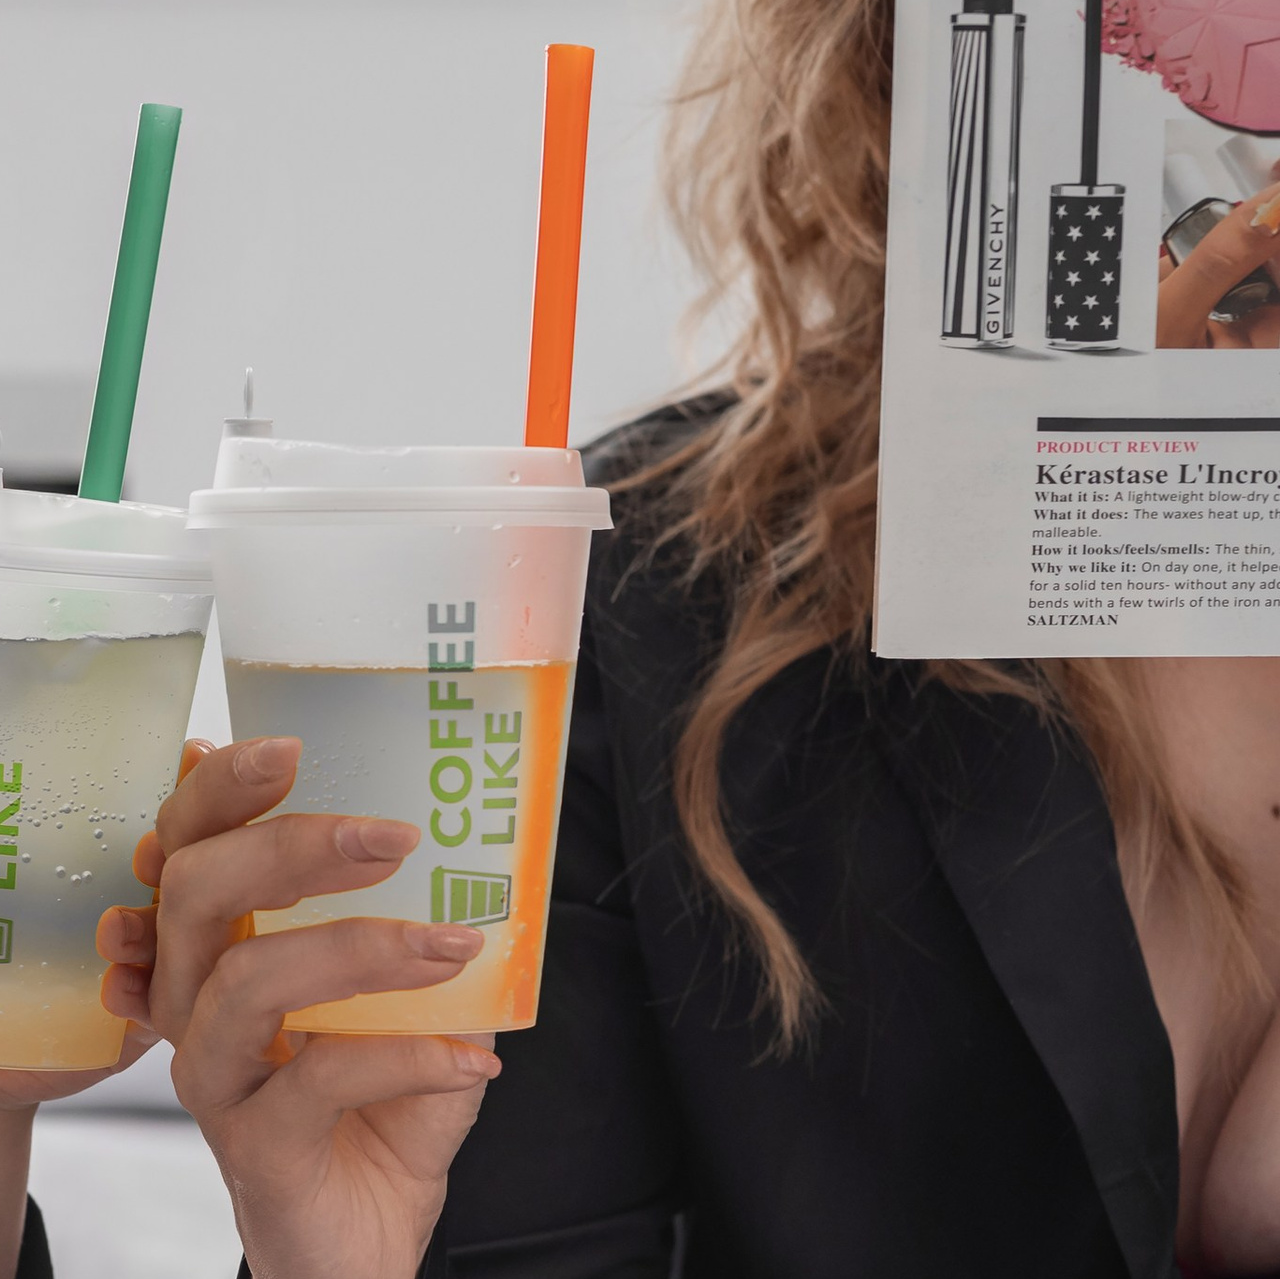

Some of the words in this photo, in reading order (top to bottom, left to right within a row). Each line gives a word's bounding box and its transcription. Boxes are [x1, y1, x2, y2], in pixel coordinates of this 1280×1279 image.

[986, 204, 1004, 334] GIVENCHY
[1037, 441, 1121, 453] PRODUCT
[1127, 441, 1198, 452] REVIEW
[1035, 464, 1167, 484] Kérastase
[1178, 464, 1280, 488] L'Incro
[1034, 491, 1072, 502] What
[1078, 491, 1087, 502] it
[1092, 491, 1108, 501] is:
[1114, 491, 1123, 501] A
[1128, 491, 1203, 504] lightweight
[1208, 491, 1268, 503] blow-dry
[1033, 509, 1071, 520] What
[1076, 509, 1086, 519] it
[1091, 509, 1127, 519] does:
[1133, 509, 1157, 519] The
[1163, 511, 1203, 519] waxes
[1208, 508, 1237, 519] heat
[1243, 511, 1263, 521] up,
[1032, 545, 1062, 555] How
[1068, 544, 1076, 554] it
[1215, 544, 1239, 554] The
[1244, 544, 1274, 555] thin,
[1027, 614, 1118, 625] SALTZMAN
[427, 600, 476, 848] COFFEE
[483, 711, 522, 845] LIKE
